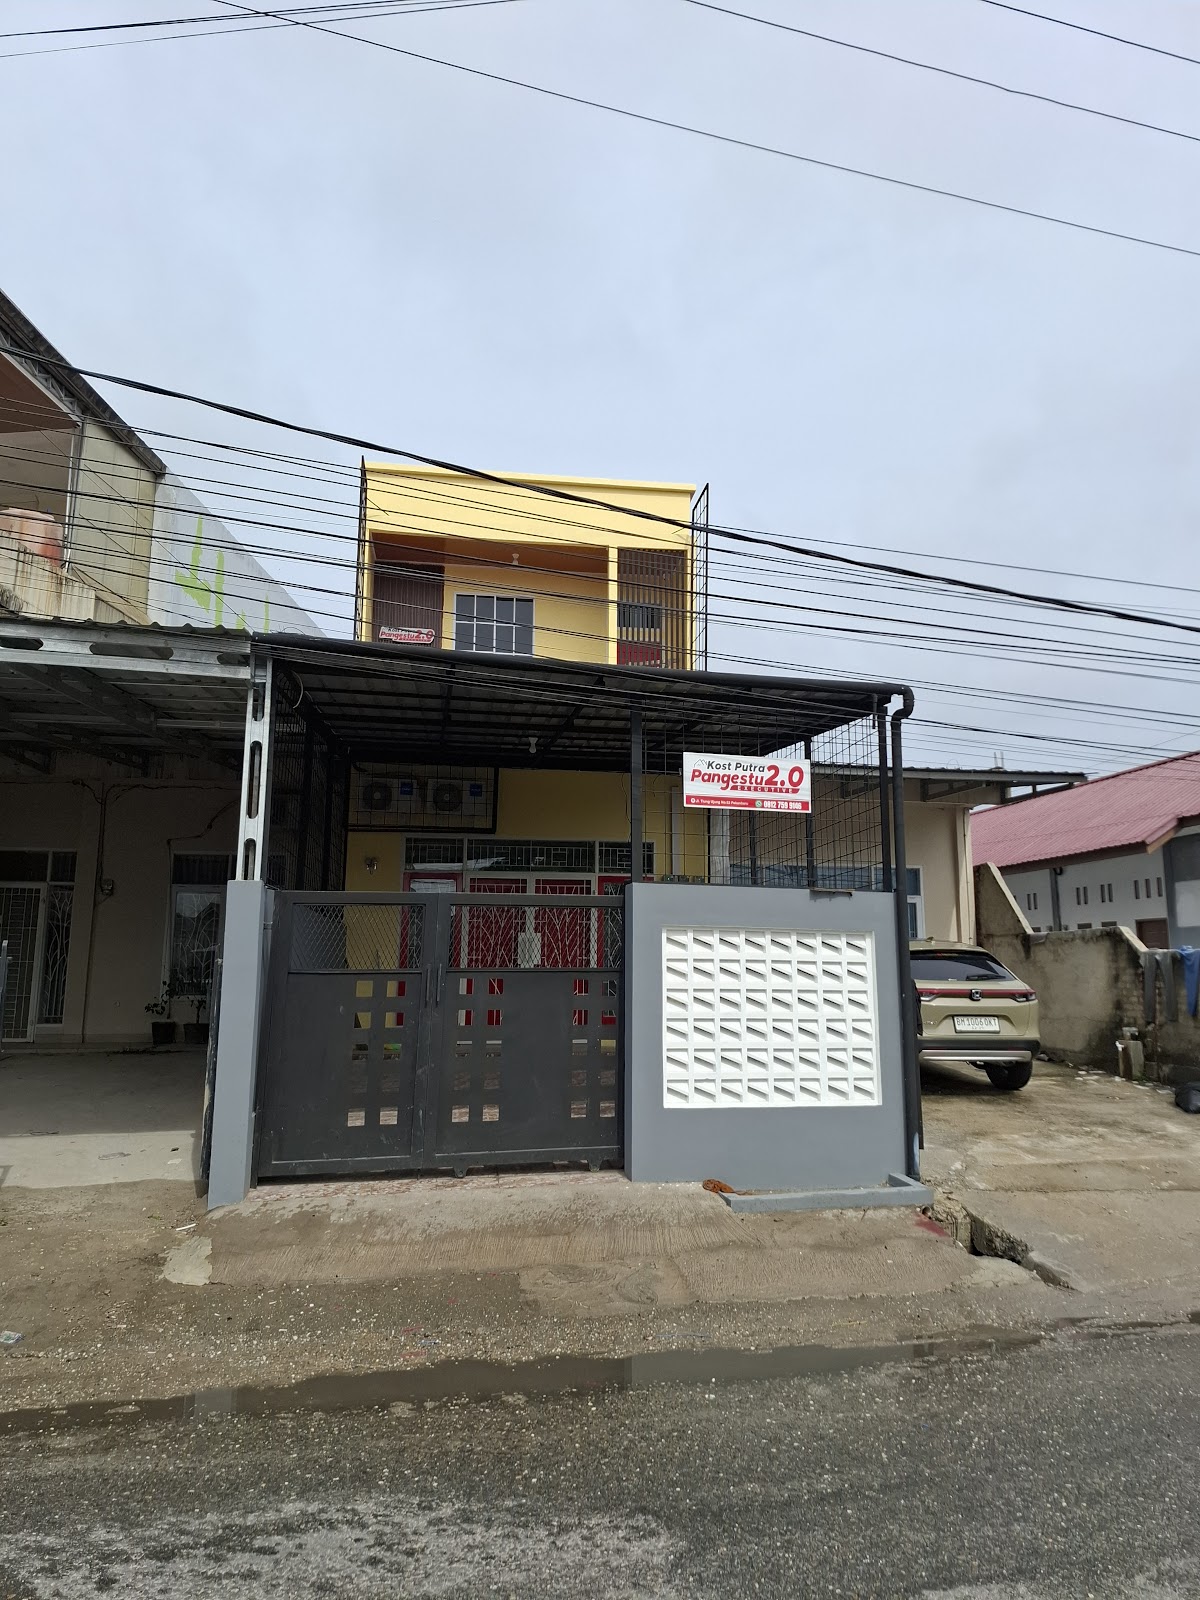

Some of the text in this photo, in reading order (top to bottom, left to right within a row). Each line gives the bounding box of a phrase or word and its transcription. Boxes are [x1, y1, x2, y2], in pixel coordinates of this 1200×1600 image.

[381, 632, 414, 640] Pangestu
[415, 630, 433, 639] 2.0
[707, 760, 765, 772] Kost Putra
[691, 765, 804, 790] Pangestu 2.0
[737, 786, 793, 794] EXECUTIVE
[763, 800, 777, 809] 0812
[777, 801, 788, 809] 759
[956, 1017, 966, 1026] BM
[966, 1017, 983, 1026] 1006
